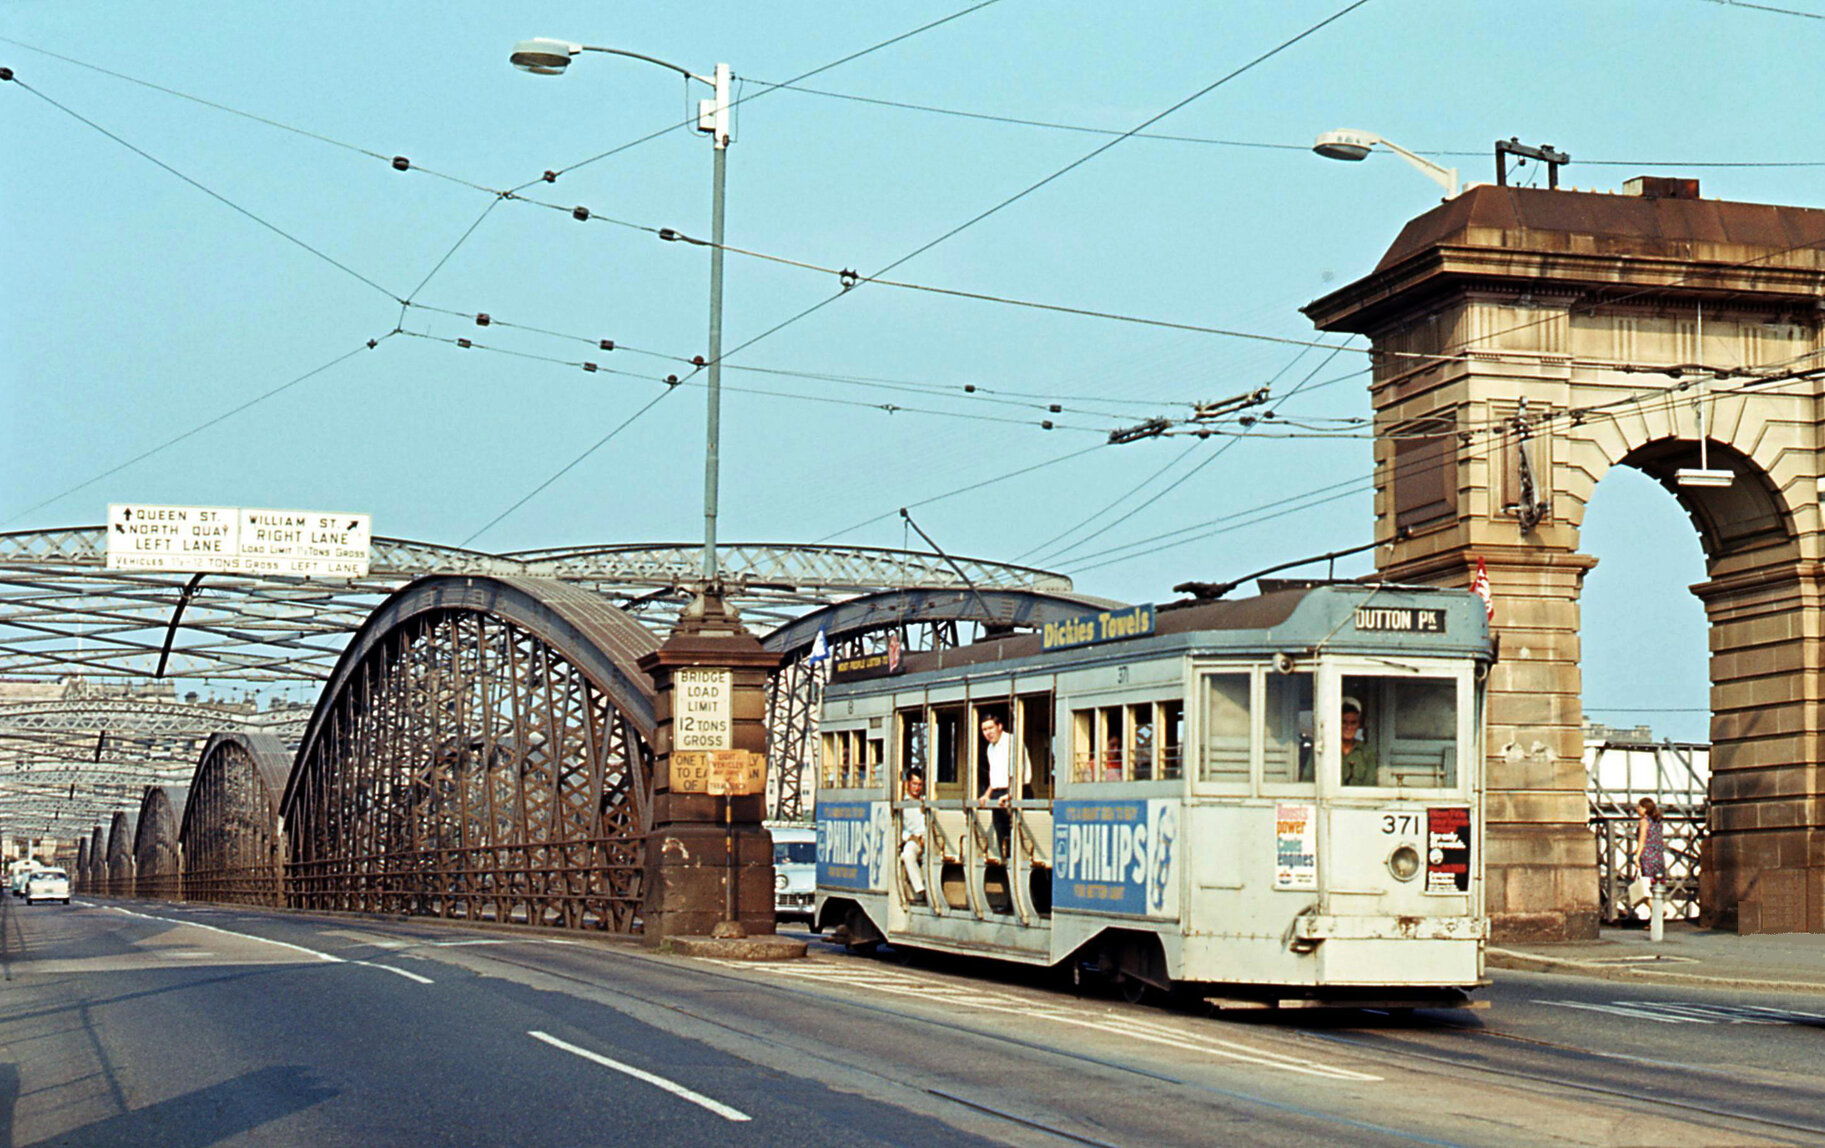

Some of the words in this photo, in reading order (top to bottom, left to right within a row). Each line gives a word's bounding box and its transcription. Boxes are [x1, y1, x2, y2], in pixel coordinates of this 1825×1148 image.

[137, 509, 187, 520] QUEEN
[250, 515, 306, 526] WILLIAM
[130, 525, 178, 535] NORTH
[193, 525, 229, 536] QUAY
[257, 529, 302, 542] RIGHT
[312, 532, 348, 545] LANE
[136, 538, 171, 550] LEFT
[183, 540, 222, 551] LANE
[209, 558, 239, 568] TONS
[291, 562, 318, 571] LEFT
[329, 563, 360, 573] LANE
[1356, 609, 1411, 629] DUTTON
[1043, 617, 1095, 648] Dickies
[1099, 607, 1149, 639] Towels
[681, 672, 726, 683] BRIDGE
[688, 687, 719, 697] LOAD
[688, 702, 718, 712] LIMIT
[680, 717, 695, 731] 12
[697, 721, 727, 731] TONS
[684, 736, 723, 746] GROSS
[675, 755, 695, 766] ONE
[677, 768, 690, 778] TO
[683, 780, 698, 790] OF
[1277, 821, 1306, 837] power
[1382, 815, 1418, 835] 371
[826, 820, 870, 866] PHILIPS
[1068, 824, 1147, 884] PHILIPS
[1277, 854, 1314, 869] engines
